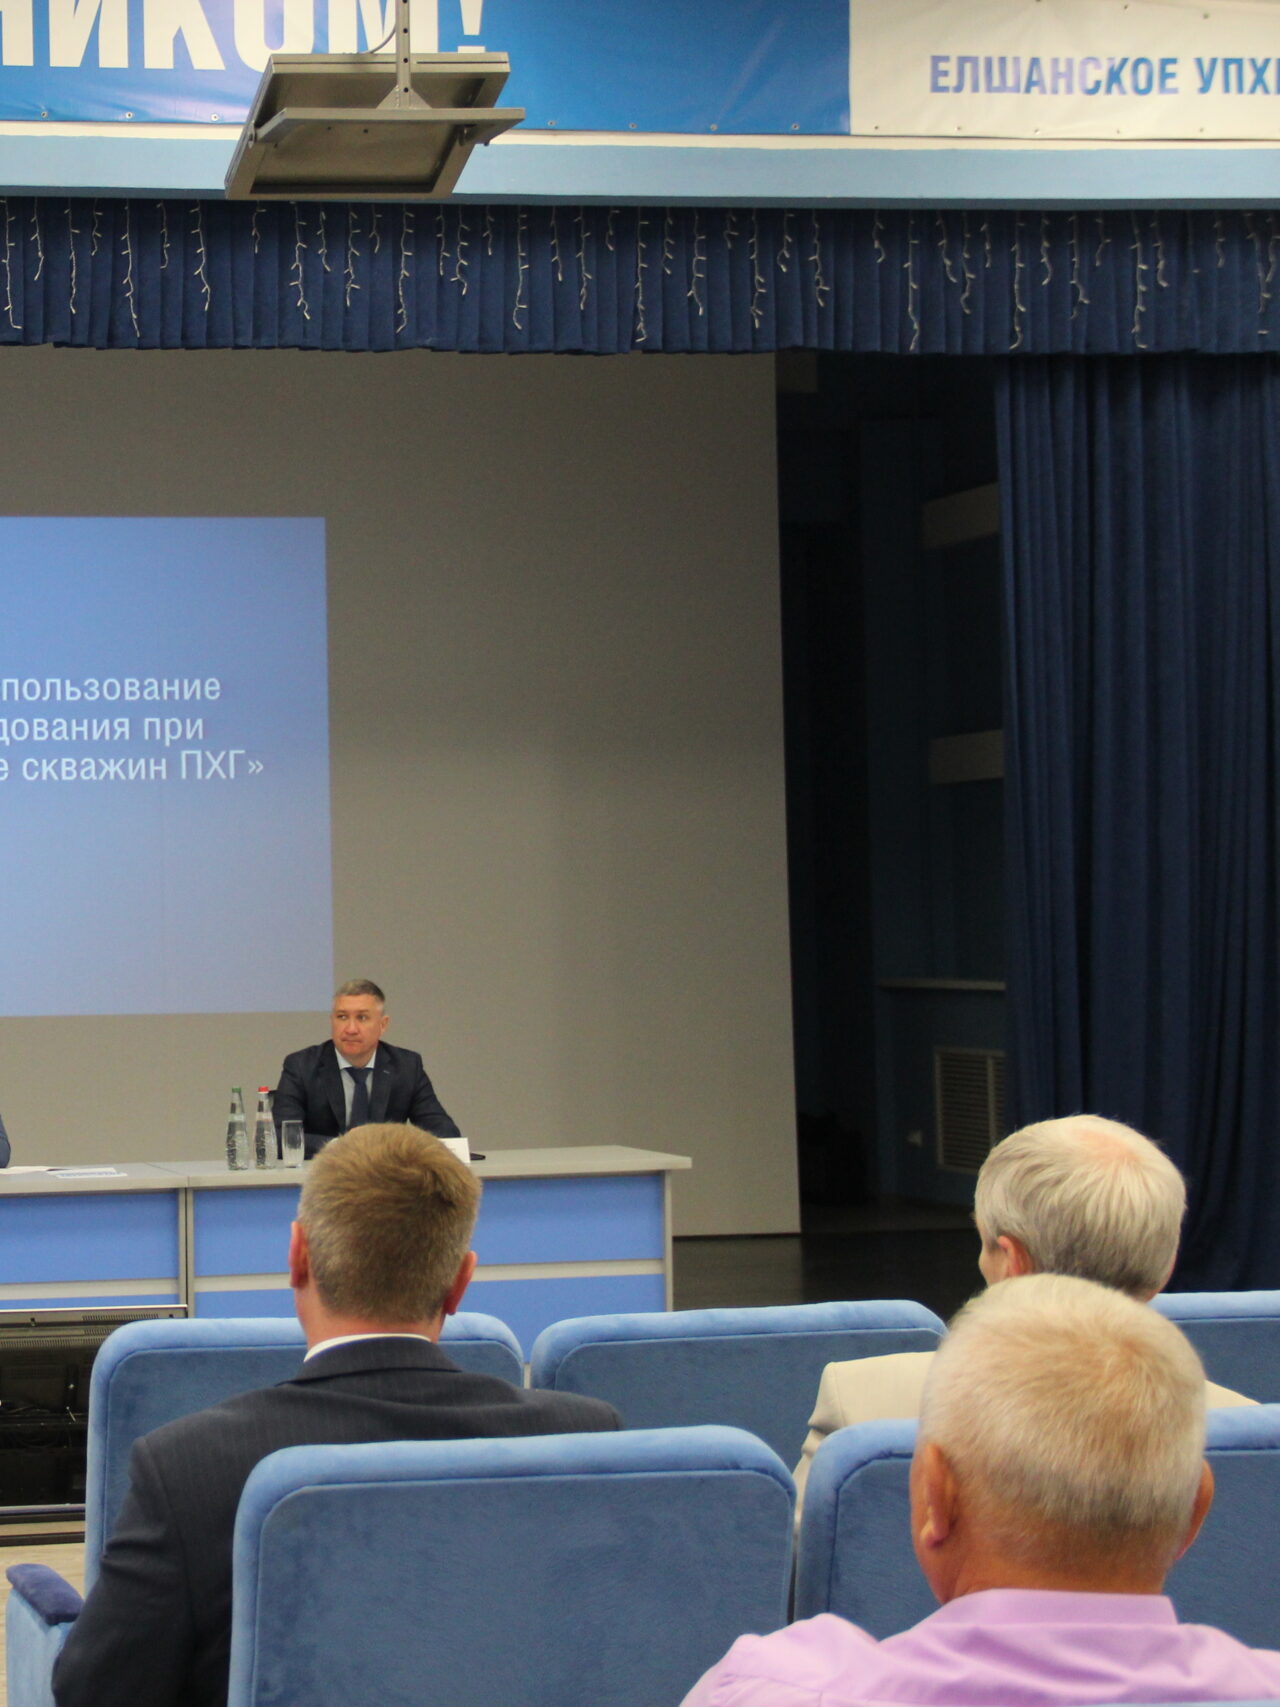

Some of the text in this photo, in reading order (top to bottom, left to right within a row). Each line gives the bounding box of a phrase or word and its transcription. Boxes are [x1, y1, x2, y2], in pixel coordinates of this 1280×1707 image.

[930, 55, 1280, 96] ЕЛШАНСКОЕ УПХ
[143, 717, 205, 746] при
[22, 755, 168, 781] скважин
[181, 750, 265, 780] ПХГ»
